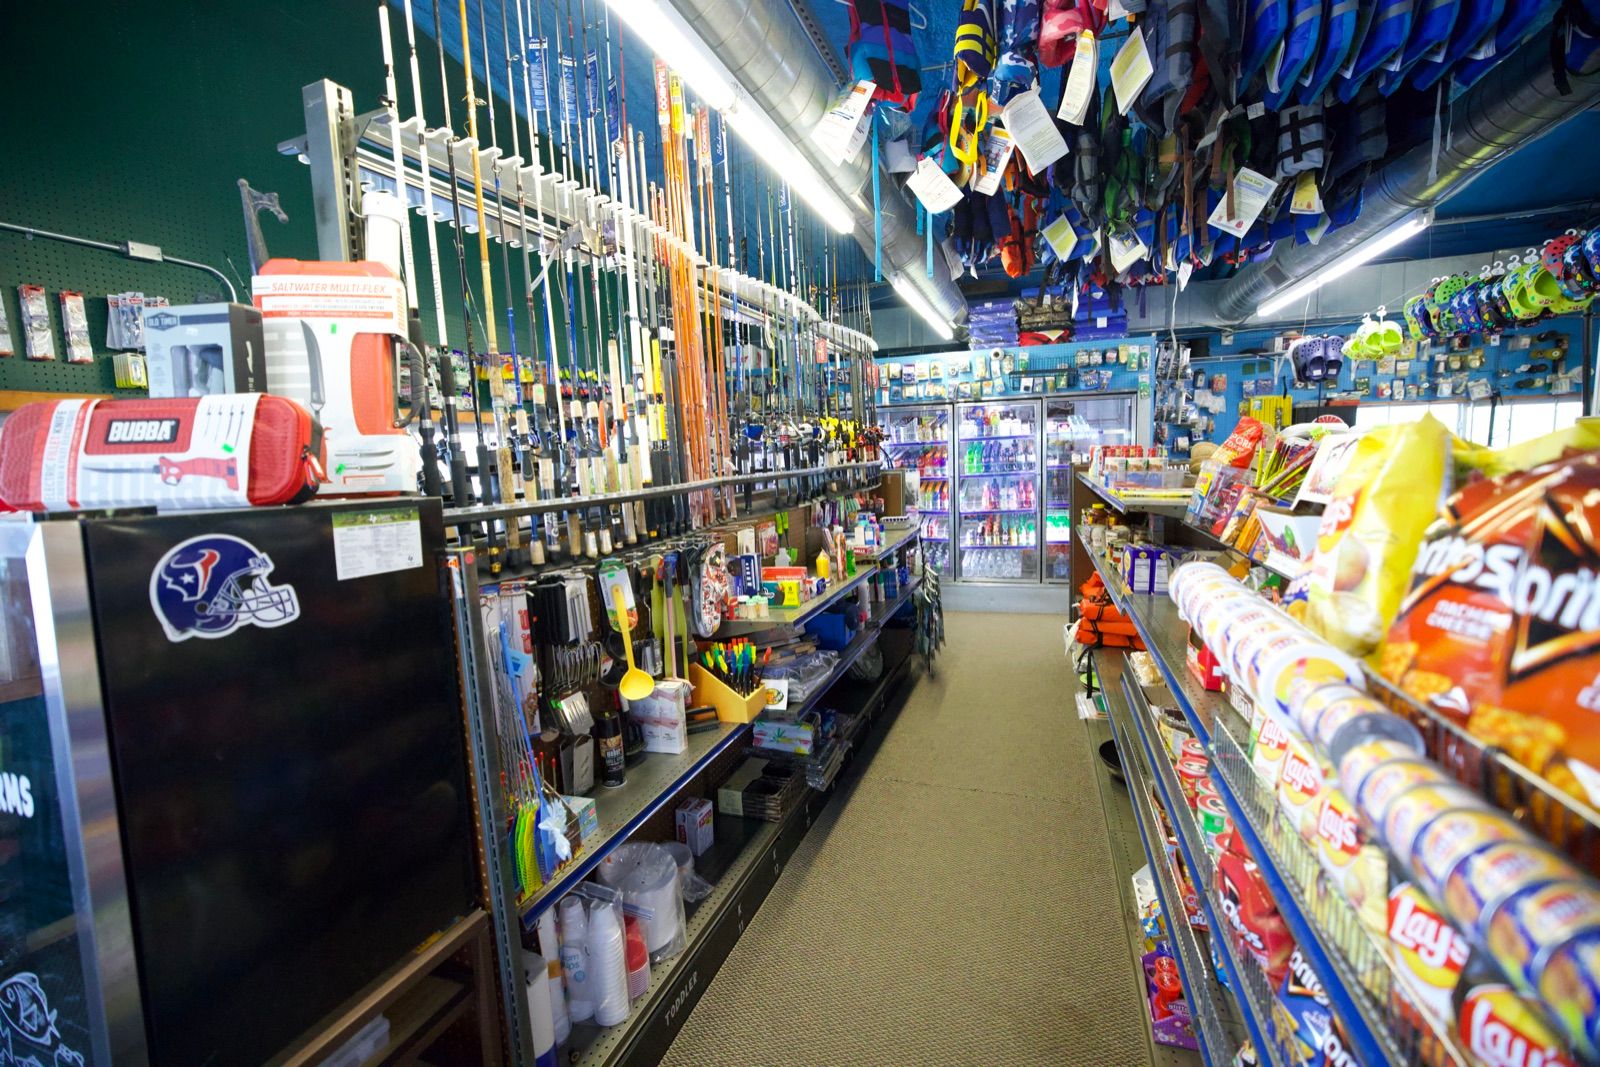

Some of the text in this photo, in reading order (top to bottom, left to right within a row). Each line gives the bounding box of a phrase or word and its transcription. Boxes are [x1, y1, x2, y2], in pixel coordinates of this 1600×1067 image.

[271, 282, 387, 294] SALTWATER MULTI-FLEX
[107, 420, 172, 443] BUBBA
[664, 970, 698, 1027] TODDLER
